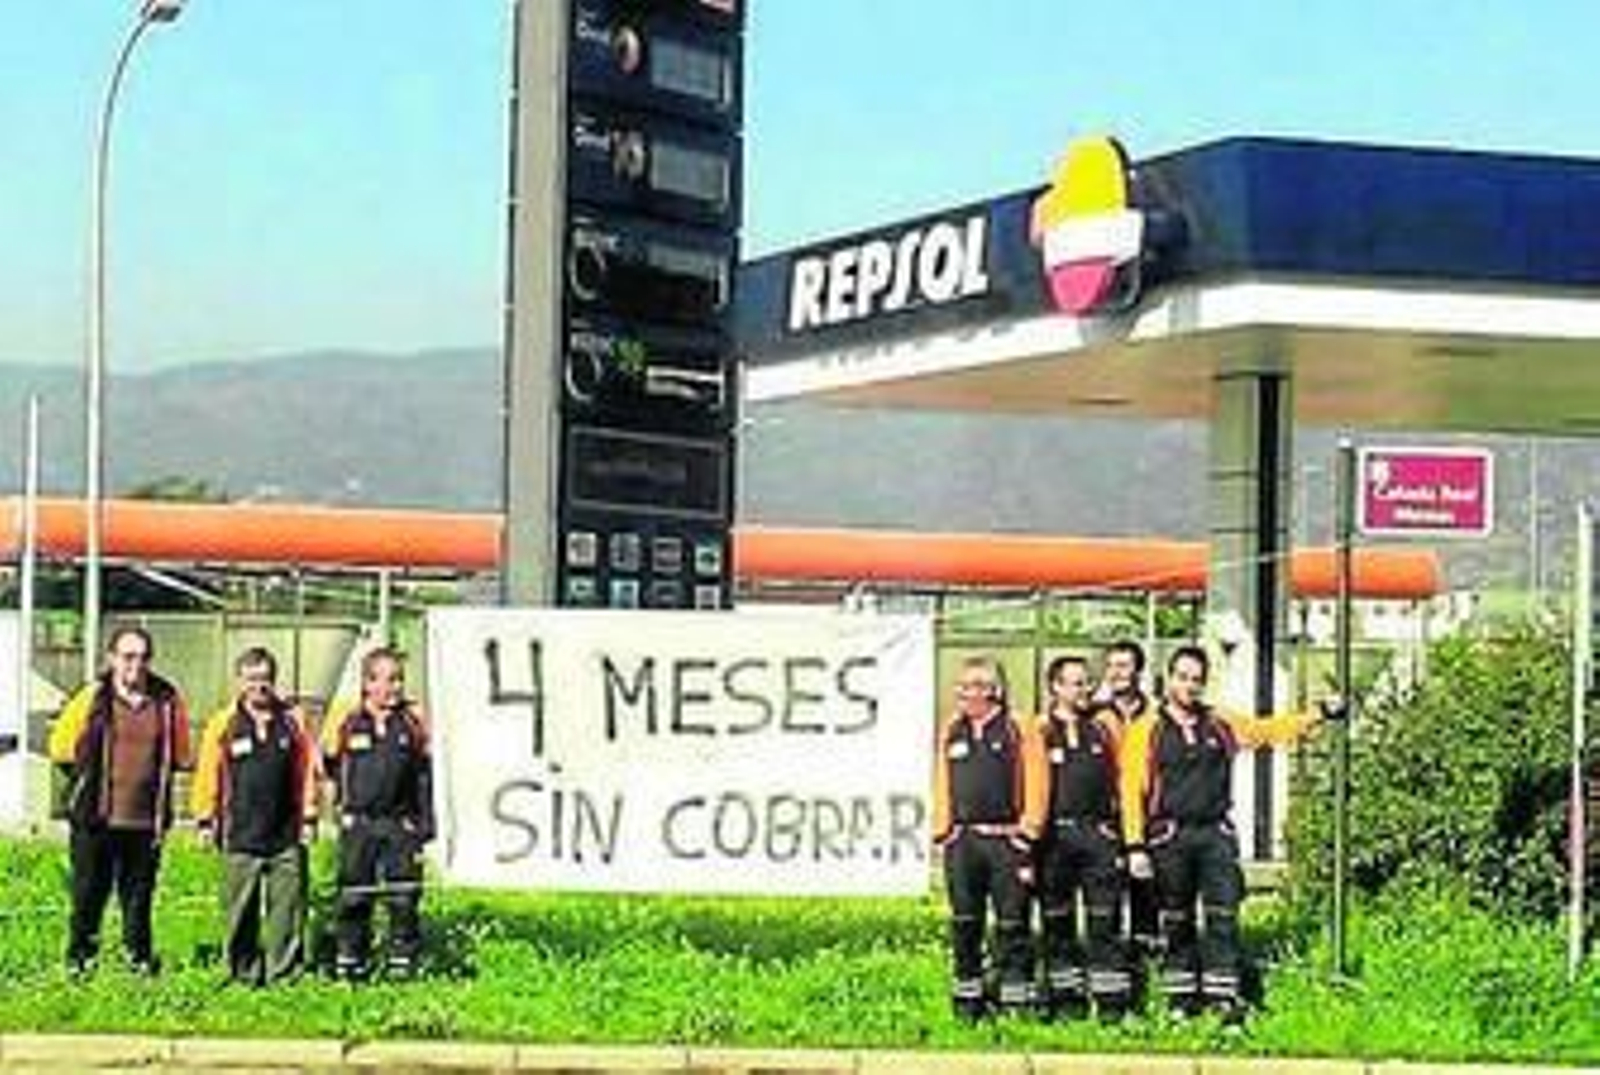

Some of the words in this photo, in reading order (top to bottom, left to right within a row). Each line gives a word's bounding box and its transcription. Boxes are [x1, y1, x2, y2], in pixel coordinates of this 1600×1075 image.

[790, 216, 989, 331] REPSOL
[485, 638, 544, 757] 4
[602, 656, 879, 741] MESES
[661, 792, 926, 864] COBRAR
